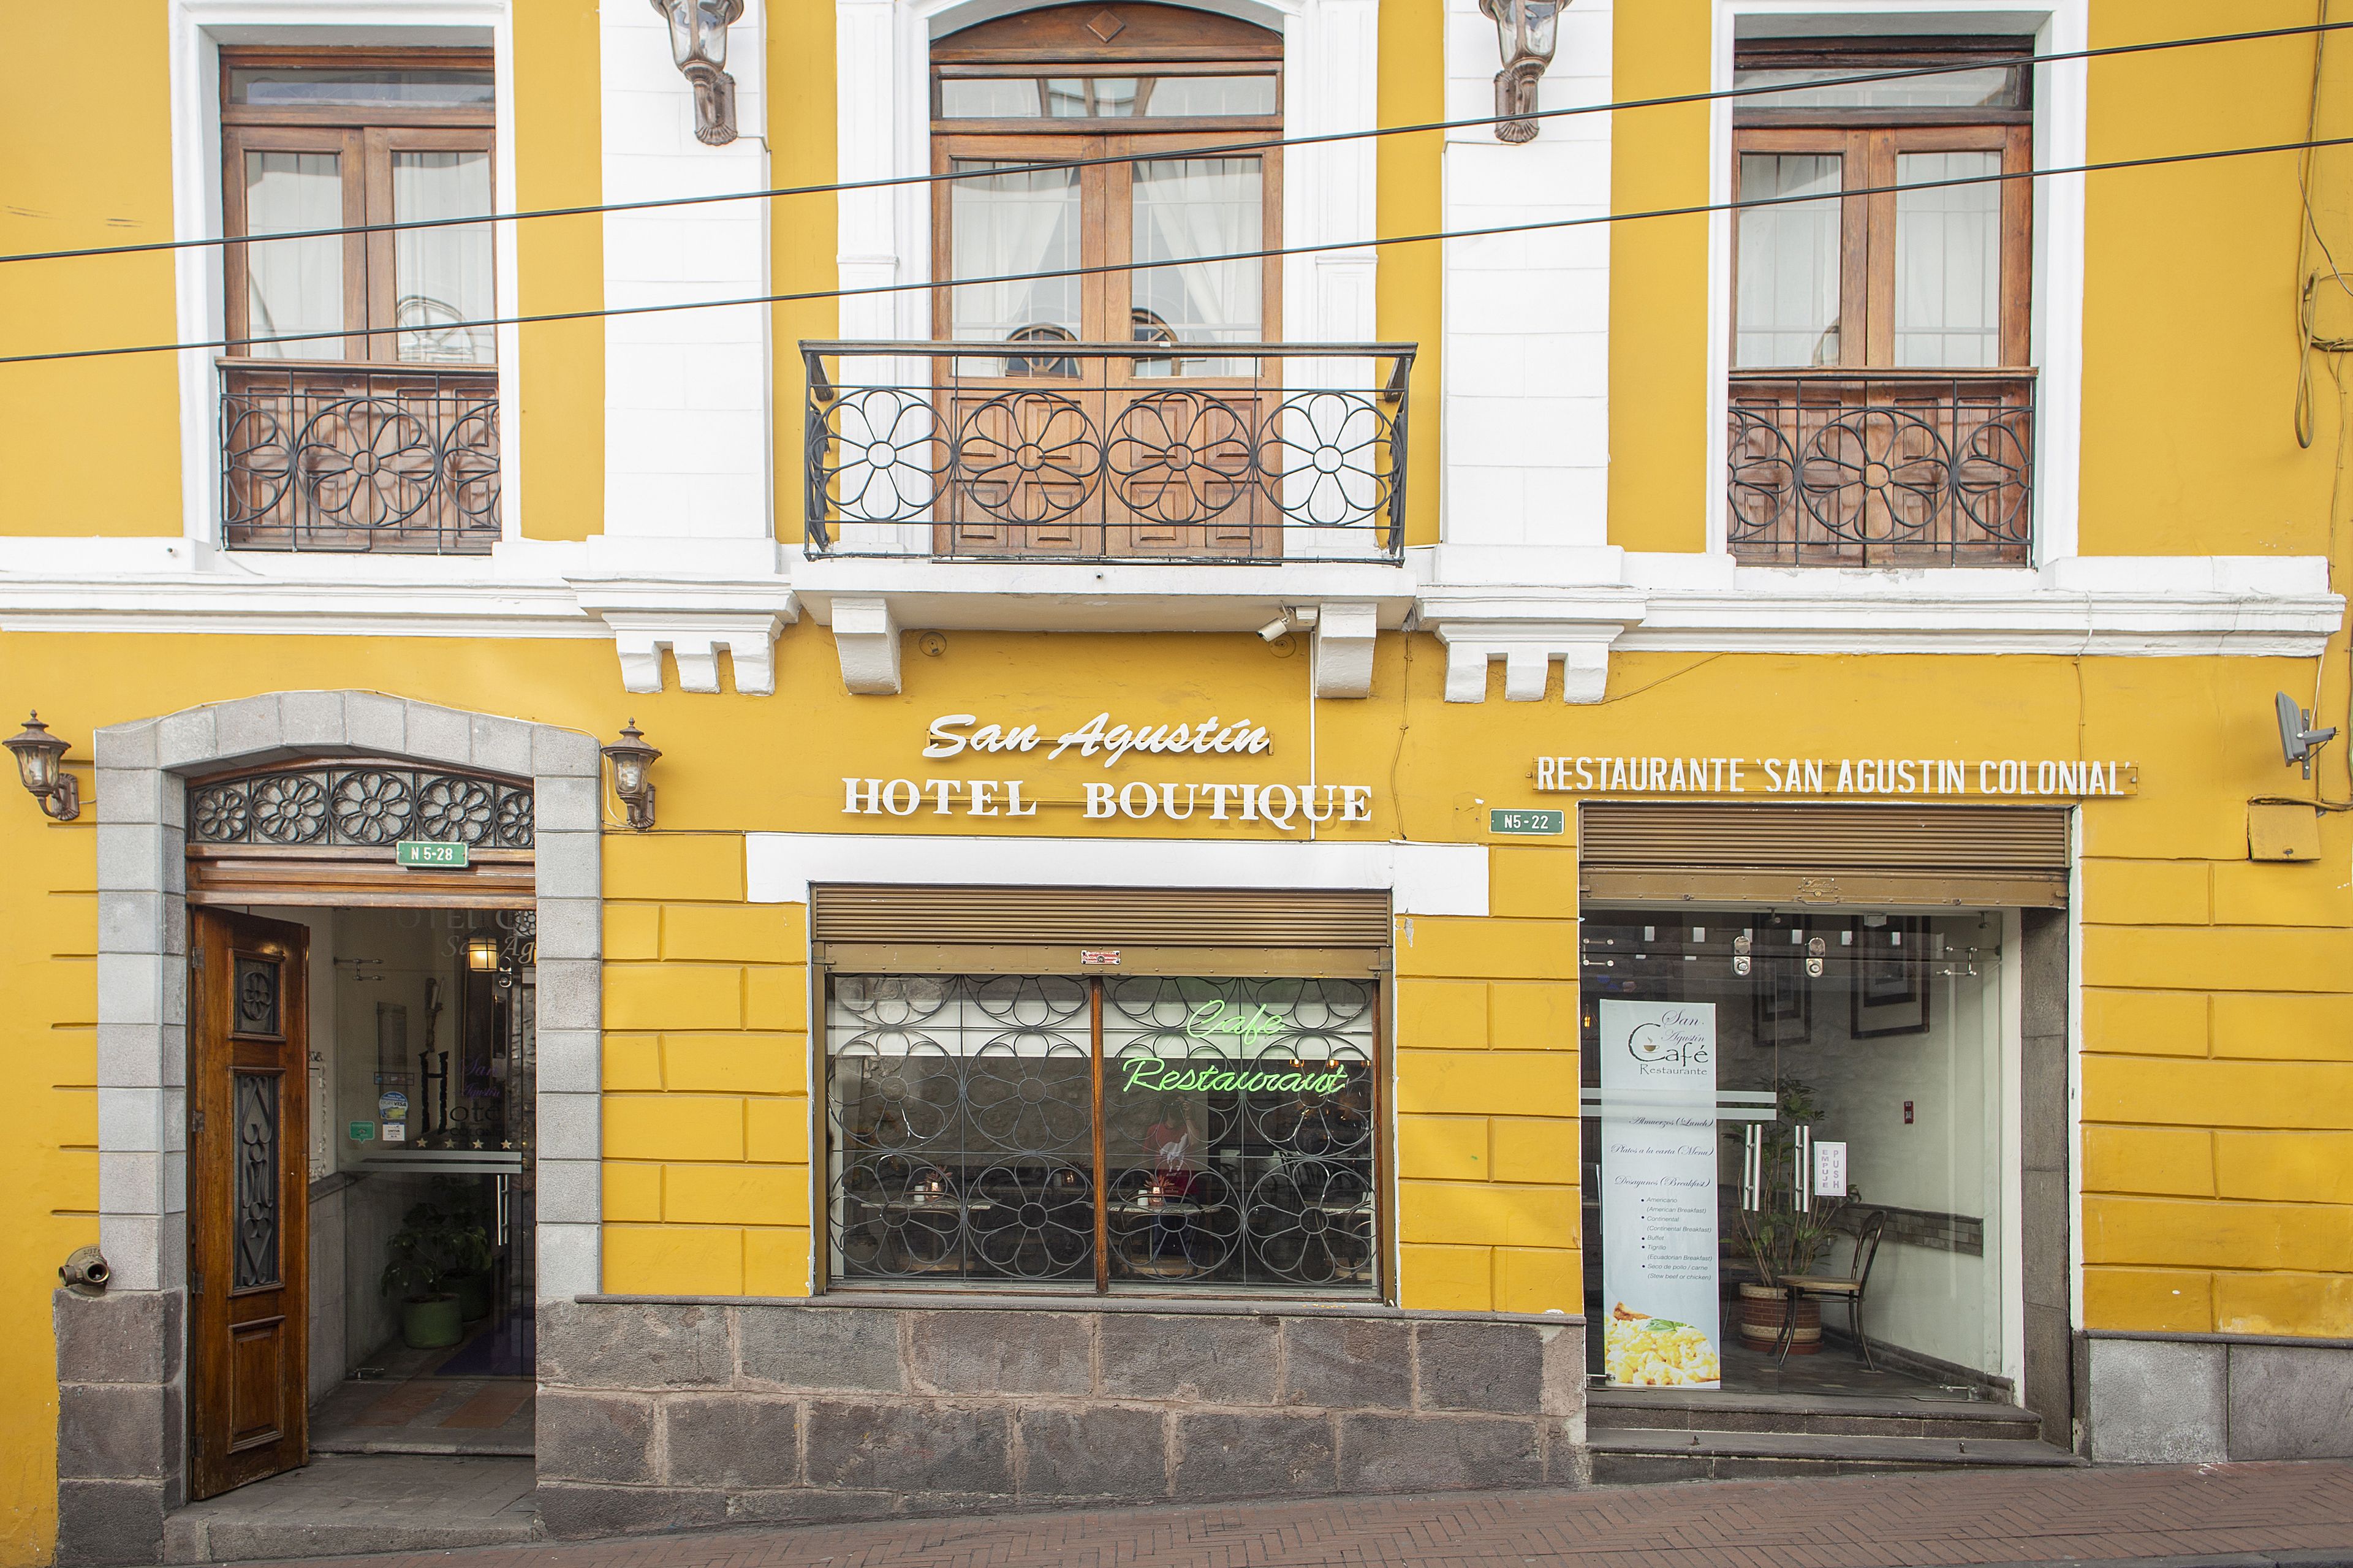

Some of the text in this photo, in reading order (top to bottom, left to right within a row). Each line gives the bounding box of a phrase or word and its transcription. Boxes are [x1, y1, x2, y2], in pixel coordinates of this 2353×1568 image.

[922, 713, 1270, 767] San Agustín
[1538, 757, 1745, 792] RESTAURANTE
[1837, 759, 1965, 793] AGUSTIN
[842, 778, 1372, 830] HOTEL BOUTIQUE
[1504, 814, 1548, 829] N5-22
[411, 847, 453, 861] N 5-28
[1187, 999, 1286, 1045] Cafe
[1662, 1009, 1699, 1028] San
[1628, 1023, 1708, 1067] Café
[1661, 1029, 1705, 1045] Agustín
[1123, 1056, 1348, 1094] Restaurant
[1640, 1064, 1707, 1075] Restaurante
[1629, 1116, 1713, 1128] Almuerzos (Lunch)
[1611, 1143, 1637, 1154] Platos
[1677, 1145, 1714, 1156] (Menu)
[1615, 1175, 1711, 1188] Desayunos (Breakfast)
